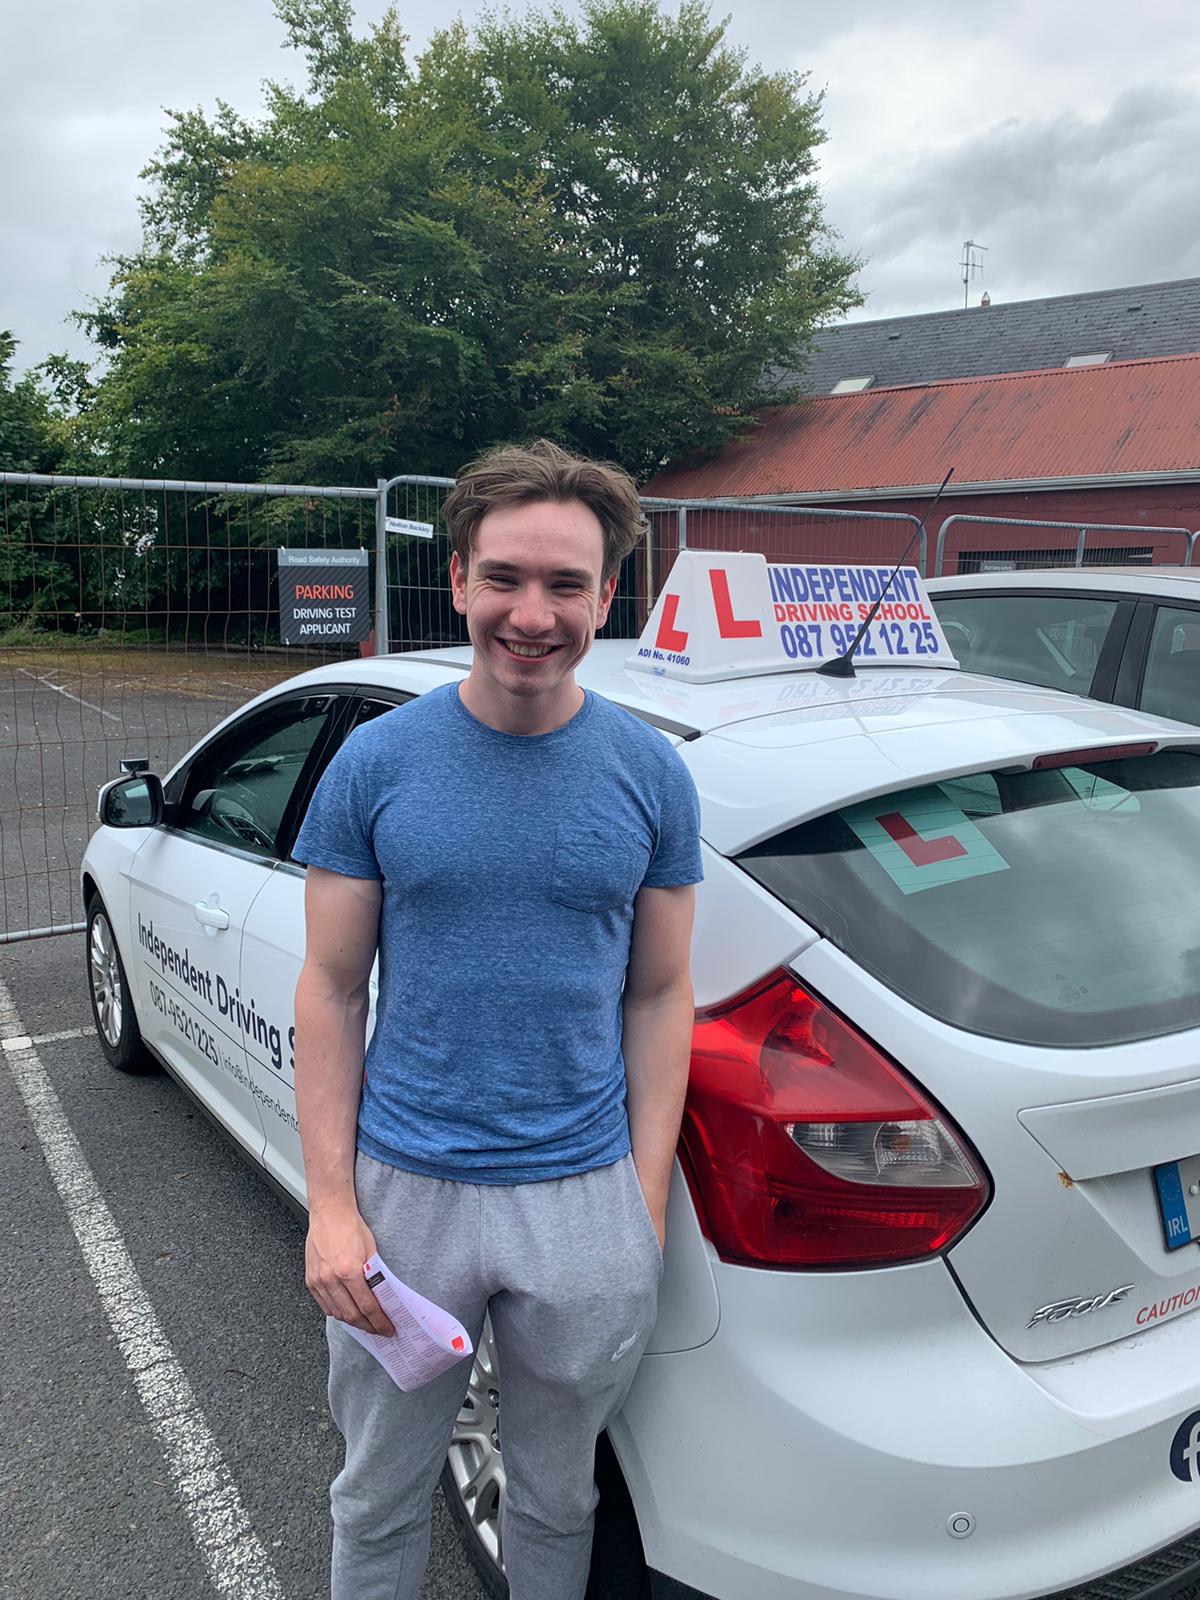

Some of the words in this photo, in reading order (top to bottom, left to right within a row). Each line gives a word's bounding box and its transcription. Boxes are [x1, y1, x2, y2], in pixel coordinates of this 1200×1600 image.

[288, 555, 307, 564] Road
[309, 556, 330, 565] Safety
[331, 556, 361, 565] Authority
[295, 584, 355, 600] PARKING
[767, 567, 921, 602] INDEPENDENT
[293, 608, 333, 619] DRIVING
[334, 607, 357, 619] TEST
[709, 569, 762, 639] L
[773, 603, 854, 622] DRIVING
[857, 603, 931, 621] SCHOOL
[299, 623, 352, 635] APPLICANT
[655, 593, 688, 653] L
[780, 624, 824, 659] 087
[830, 623, 877, 657] 952
[879, 622, 909, 656] 12
[909, 622, 939, 655] 25
[638, 648, 652, 658] ADI
[653, 651, 665, 661] No.
[667, 653, 691, 666] 41060
[875, 811, 968, 867] L
[137, 912, 213, 1007] Independent
[216, 974, 282, 1070] Driving
[149, 979, 219, 1067] 087-9521225
[1167, 1215, 1189, 1238] IRL
[1025, 1283, 1135, 1329] Focus
